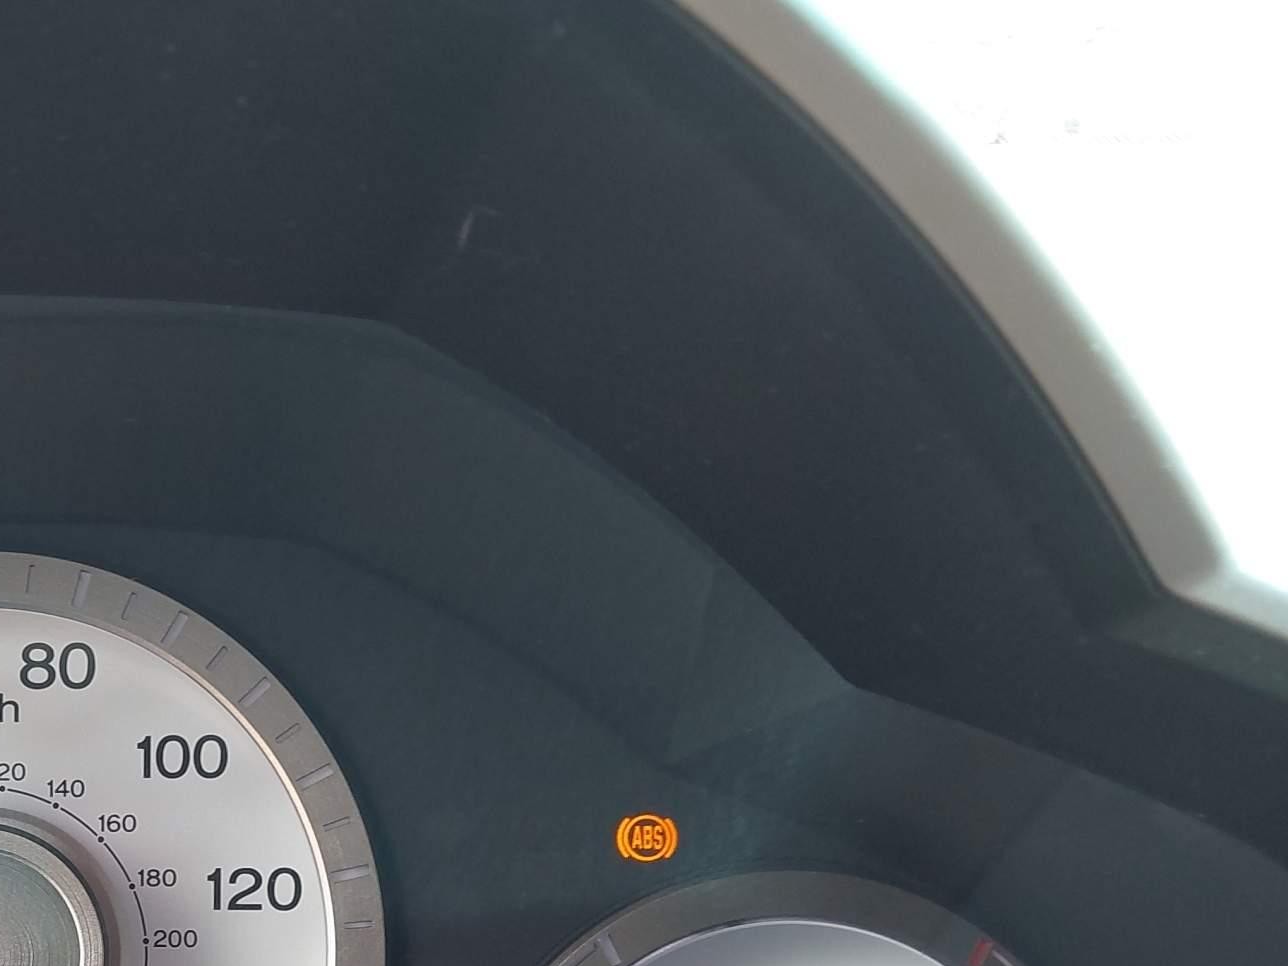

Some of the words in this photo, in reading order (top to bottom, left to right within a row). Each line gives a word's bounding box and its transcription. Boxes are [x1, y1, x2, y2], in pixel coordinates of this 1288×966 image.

[20, 643, 96, 689] 80
[136, 735, 228, 779] 100
[47, 780, 85, 798] 140
[98, 814, 136, 833] 160
[631, 825, 663, 850] ABS
[139, 870, 176, 888] 180
[208, 867, 301, 911] 120
[153, 930, 197, 949] 200
